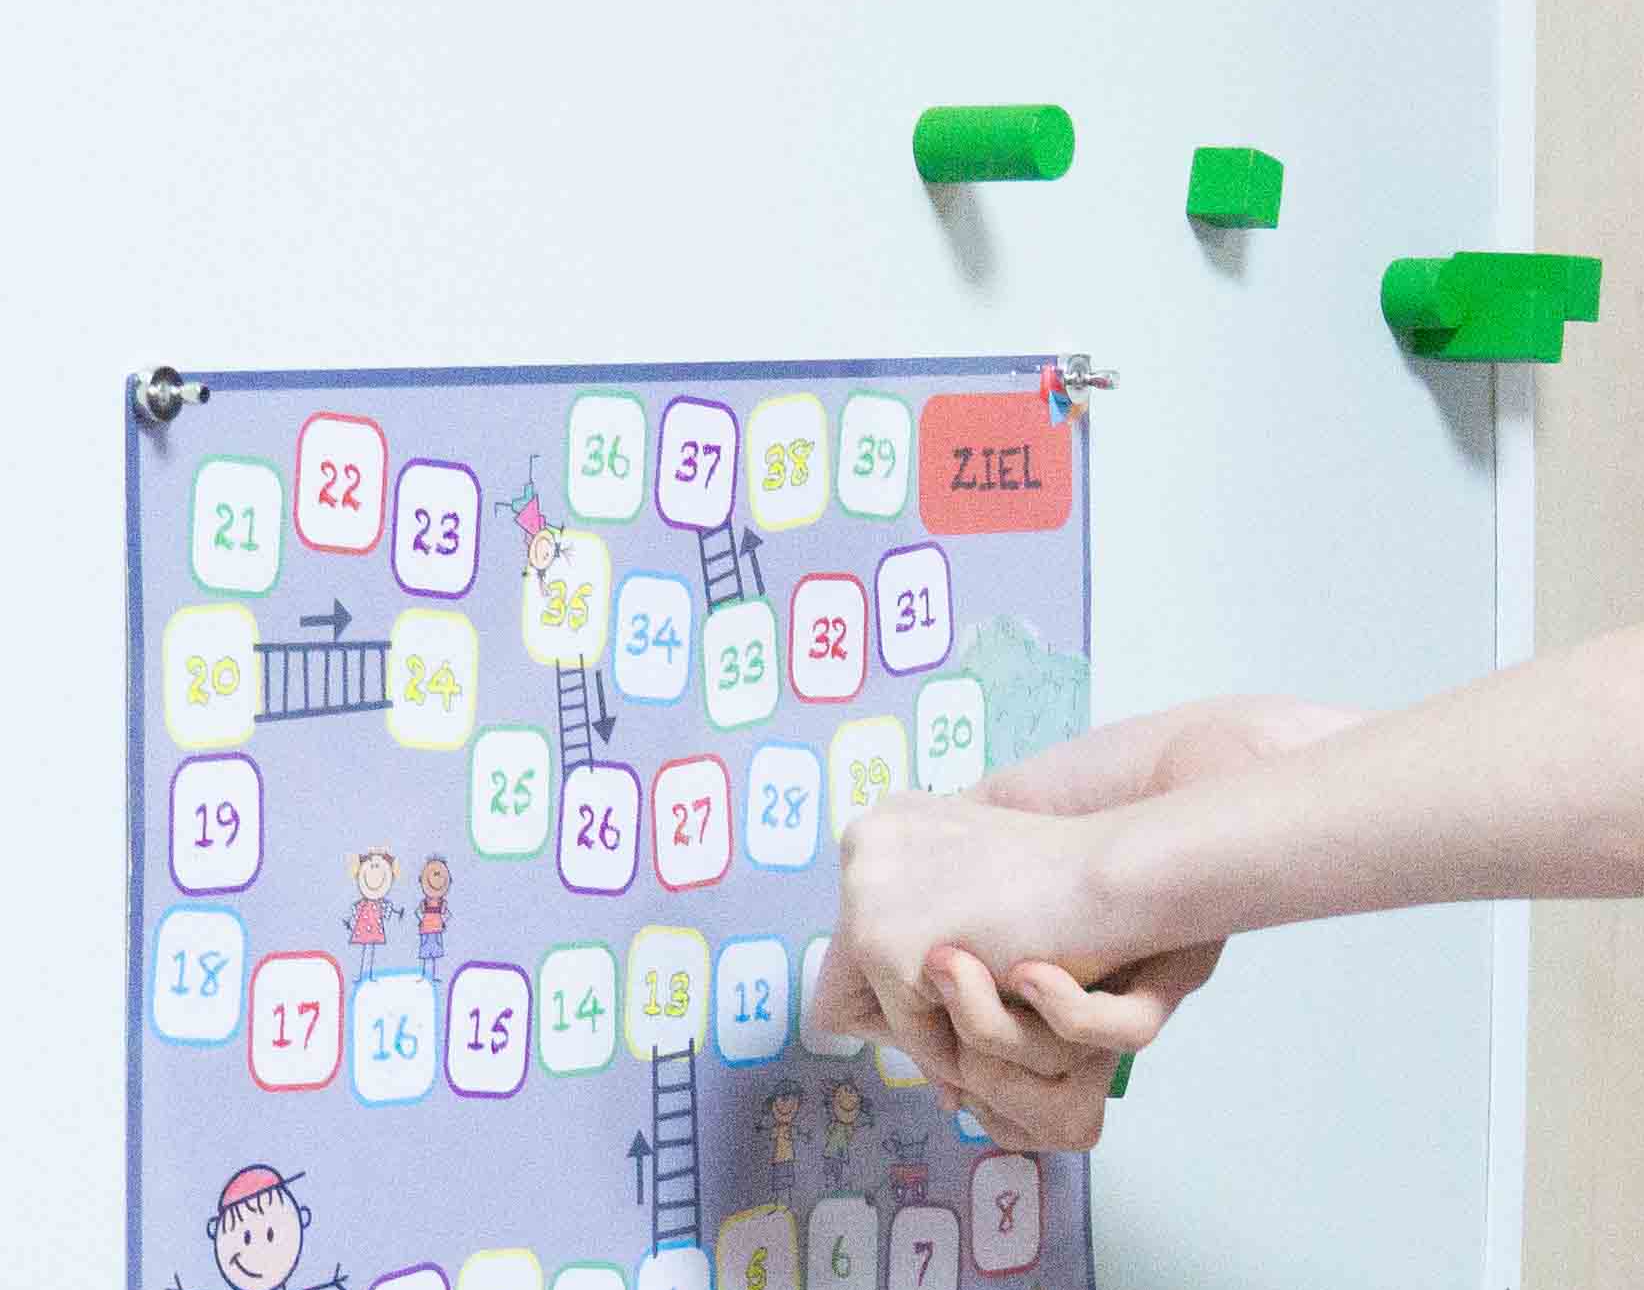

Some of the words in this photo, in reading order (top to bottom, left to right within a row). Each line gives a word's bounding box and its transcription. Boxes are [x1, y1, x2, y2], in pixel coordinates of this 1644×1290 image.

[582, 434, 631, 480] 36
[674, 440, 722, 490] 37
[761, 437, 816, 492] 38
[852, 435, 897, 479] 39
[950, 443, 1042, 493] ZIEL
[318, 460, 363, 512] 22
[213, 502, 260, 551] 21
[413, 508, 461, 555] 23
[540, 580, 594, 631] 35
[894, 587, 937, 633] 31
[625, 613, 683, 665] 34
[808, 617, 849, 662] 32
[186, 655, 241, 705] 20
[403, 655, 461, 712] 24
[717, 639, 766, 691] 33
[929, 716, 973, 759] 30
[490, 768, 536, 816] 25
[760, 783, 811, 830] 28
[194, 801, 241, 849] 19
[576, 803, 622, 852] 26
[671, 797, 713, 847] 27
[170, 949, 230, 999] 18
[642, 969, 691, 1018] 13
[271, 999, 321, 1050] 17
[551, 986, 606, 1033] 14
[734, 978, 771, 1025] 12
[371, 1014, 419, 1062] 16
[466, 1007, 514, 1055] 15
[830, 1235, 852, 1279] 6
[913, 1239, 936, 1288] 7
